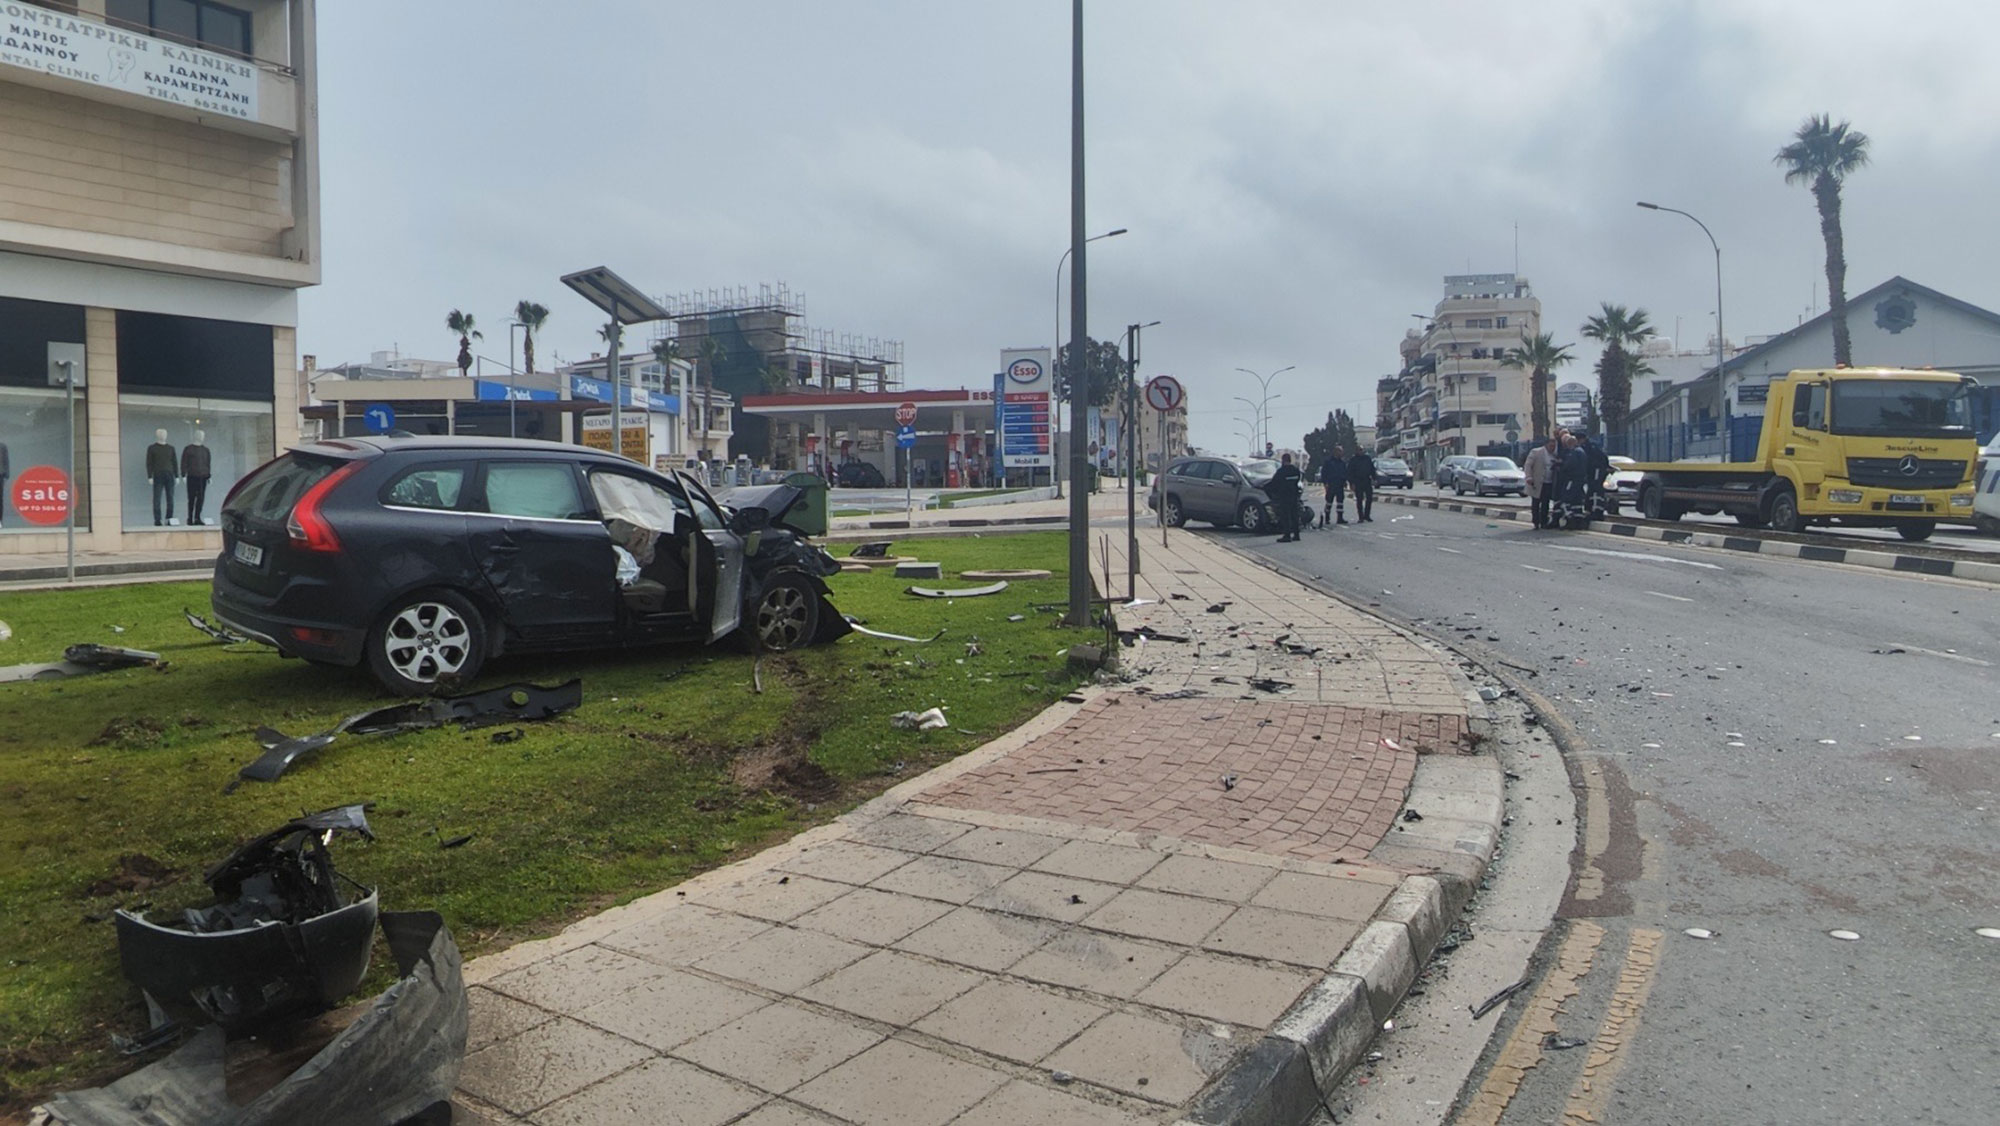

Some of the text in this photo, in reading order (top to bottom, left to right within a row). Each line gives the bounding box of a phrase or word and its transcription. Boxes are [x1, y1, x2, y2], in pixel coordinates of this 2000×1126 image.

[10, 23, 68, 46] ΜΑΡΙΟΣ
[162, 45, 252, 79] ΚΛΙΝΙΚΗ
[47, 63, 100, 82] CLINIC
[169, 64, 229, 87] ΙΩΑΝΝΑ
[144, 71, 249, 104] ΚΑΡΑΜΕΡΤΖΑΝΗ
[147, 86, 187, 102] ΤΗΛ.
[1013, 365, 1038, 377] Esso
[972, 391, 995, 400] ESS
[896, 408, 917, 420] STOP
[21, 486, 69, 501] sale
